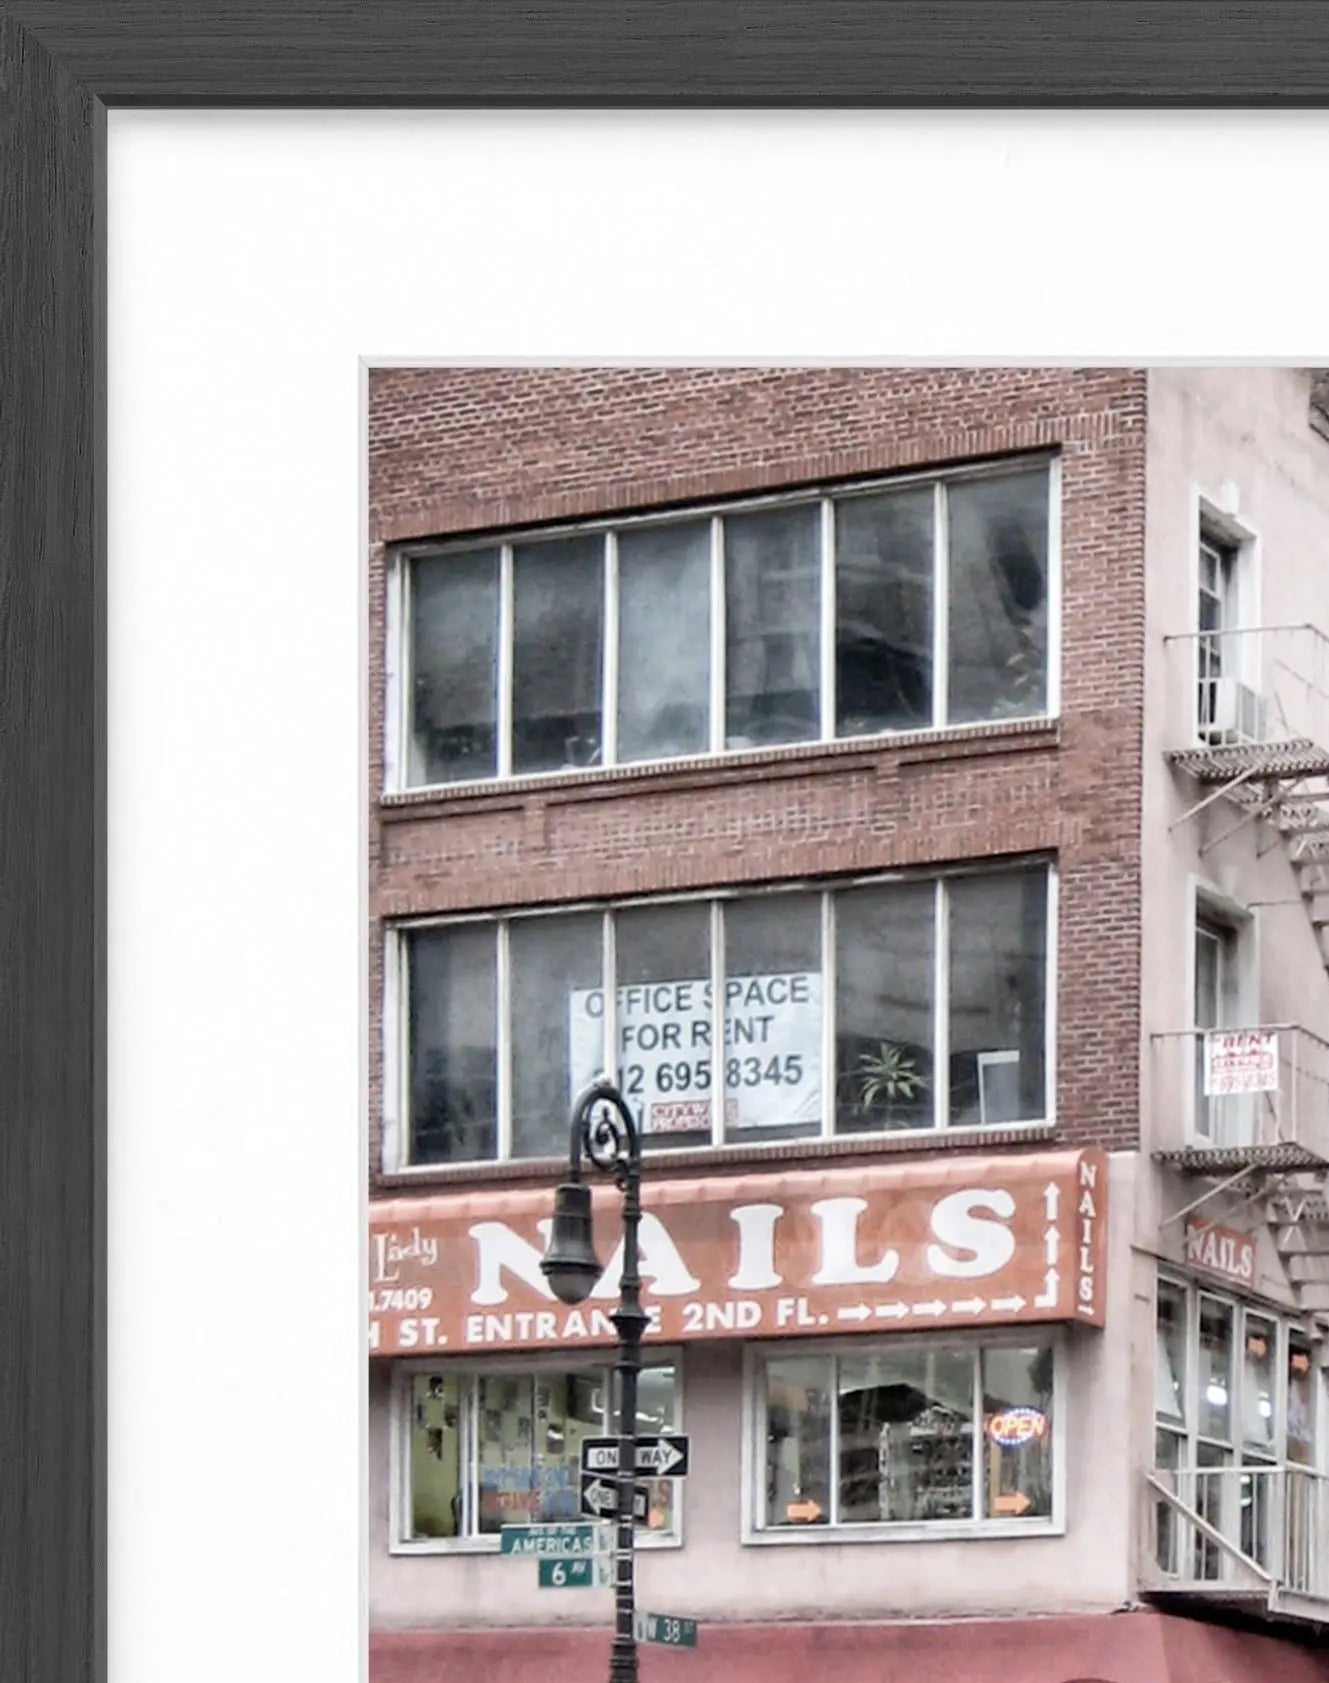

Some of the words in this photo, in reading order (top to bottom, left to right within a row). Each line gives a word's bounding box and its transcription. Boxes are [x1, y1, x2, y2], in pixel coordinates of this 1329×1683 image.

[622, 1022, 681, 1053] FOR
[656, 1059, 711, 1092] 695
[727, 1055, 803, 1088] 8345
[1080, 1161, 1096, 1302] NAILS
[469, 1189, 1016, 1306] NAILS
[1188, 1225, 1252, 1279] NAILS
[400, 1318, 447, 1347] ST.
[467, 1306, 661, 1343] ENTRANE
[683, 1303, 761, 1331] 2ND
[778, 1298, 828, 1327] FL.
[989, 1414, 1045, 1439] OPEN
[596, 1451, 618, 1465] ON
[641, 1450, 672, 1465] WAY
[511, 1537, 592, 1555] AMERICAS
[552, 1562, 566, 1586] 6
[664, 1619, 680, 1642] 38
